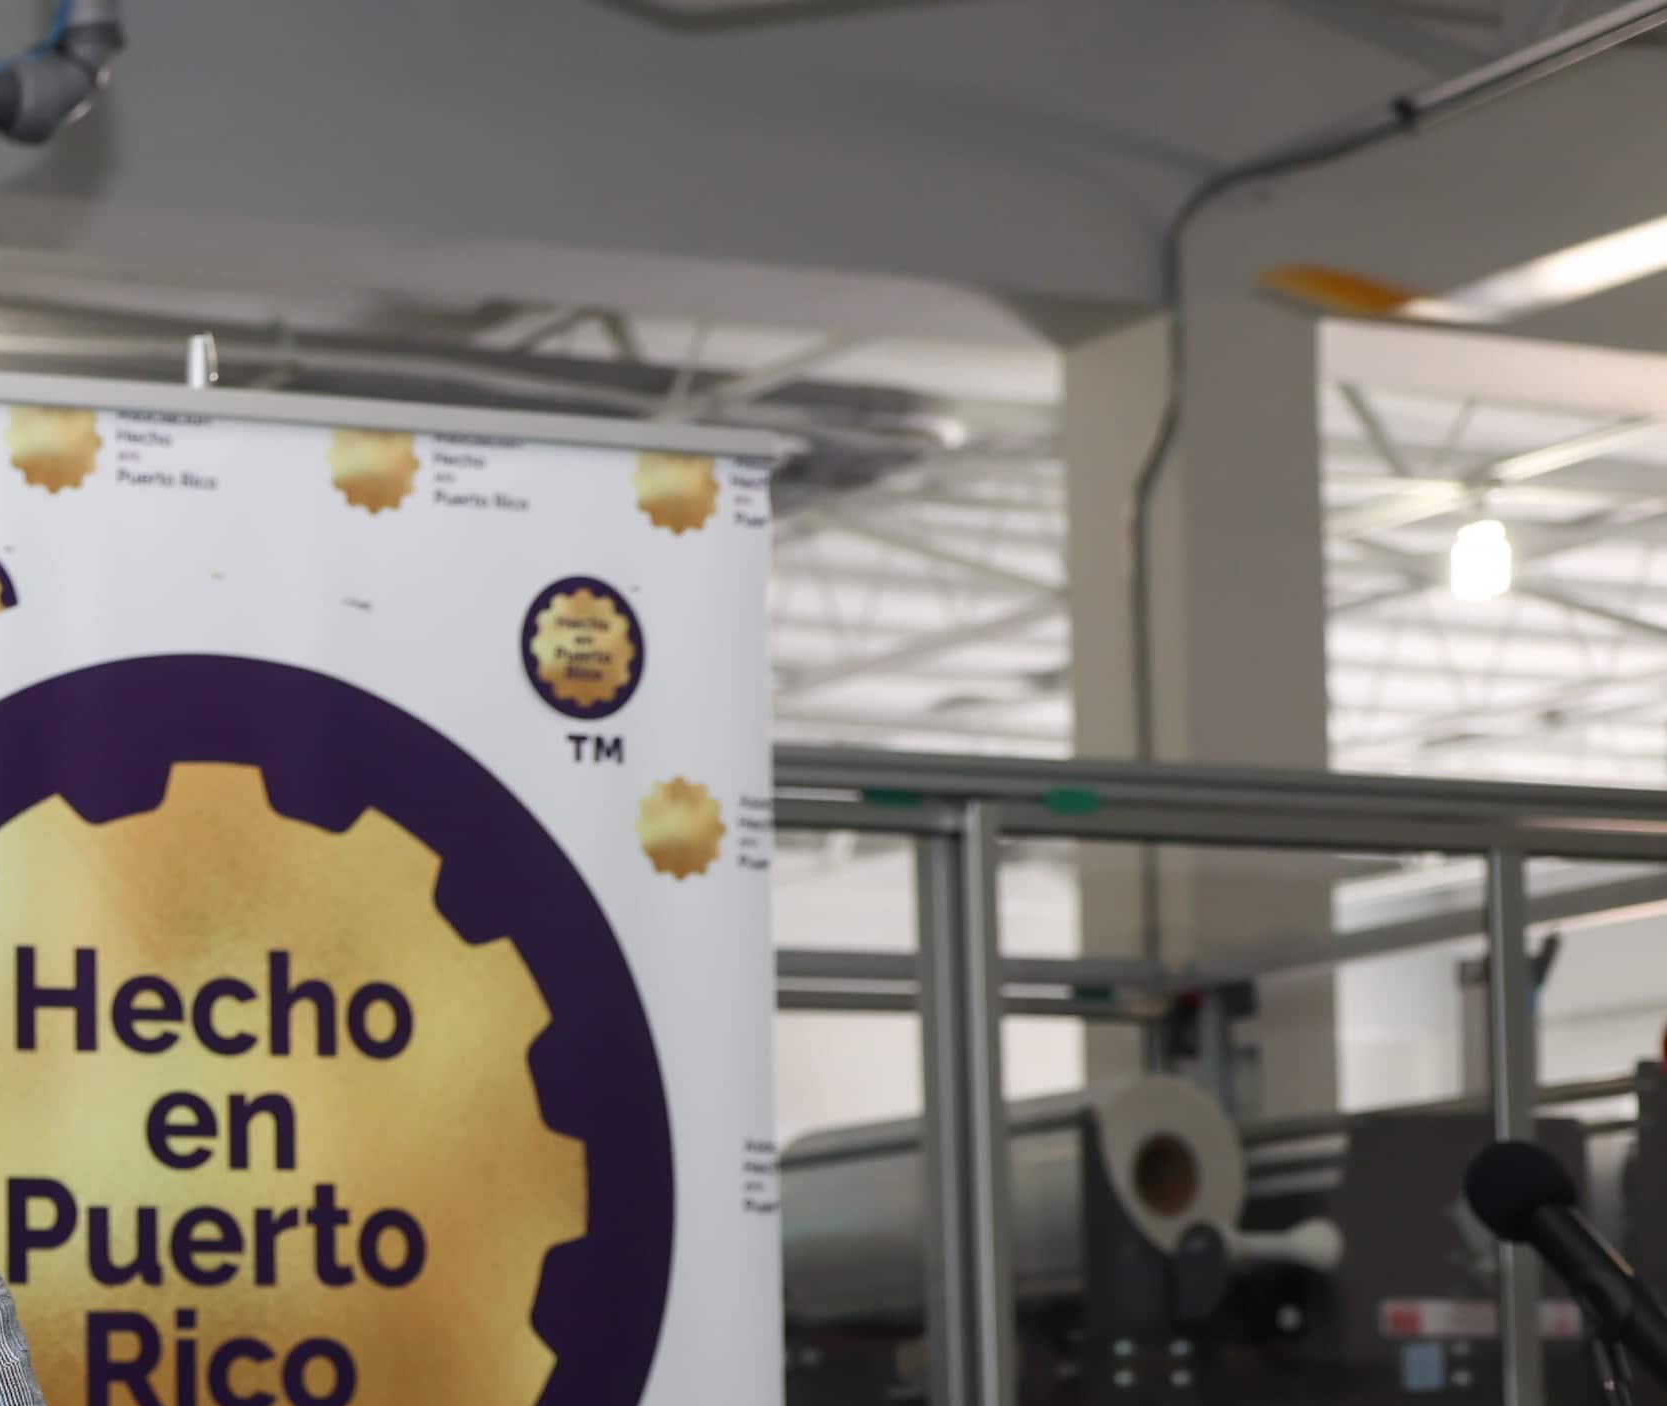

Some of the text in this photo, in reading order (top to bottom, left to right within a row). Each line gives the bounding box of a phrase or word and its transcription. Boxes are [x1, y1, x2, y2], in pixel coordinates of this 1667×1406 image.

[116, 430, 172, 446] Hecho
[432, 453, 485, 468] Hecho
[117, 469, 217, 490] Puerto Rico
[433, 490, 528, 511] Puerto Rico
[568, 736, 623, 763] TM
[16, 945, 414, 1059] Hecho
[145, 1090, 296, 1170] en
[7, 1177, 426, 1288] Puerto
